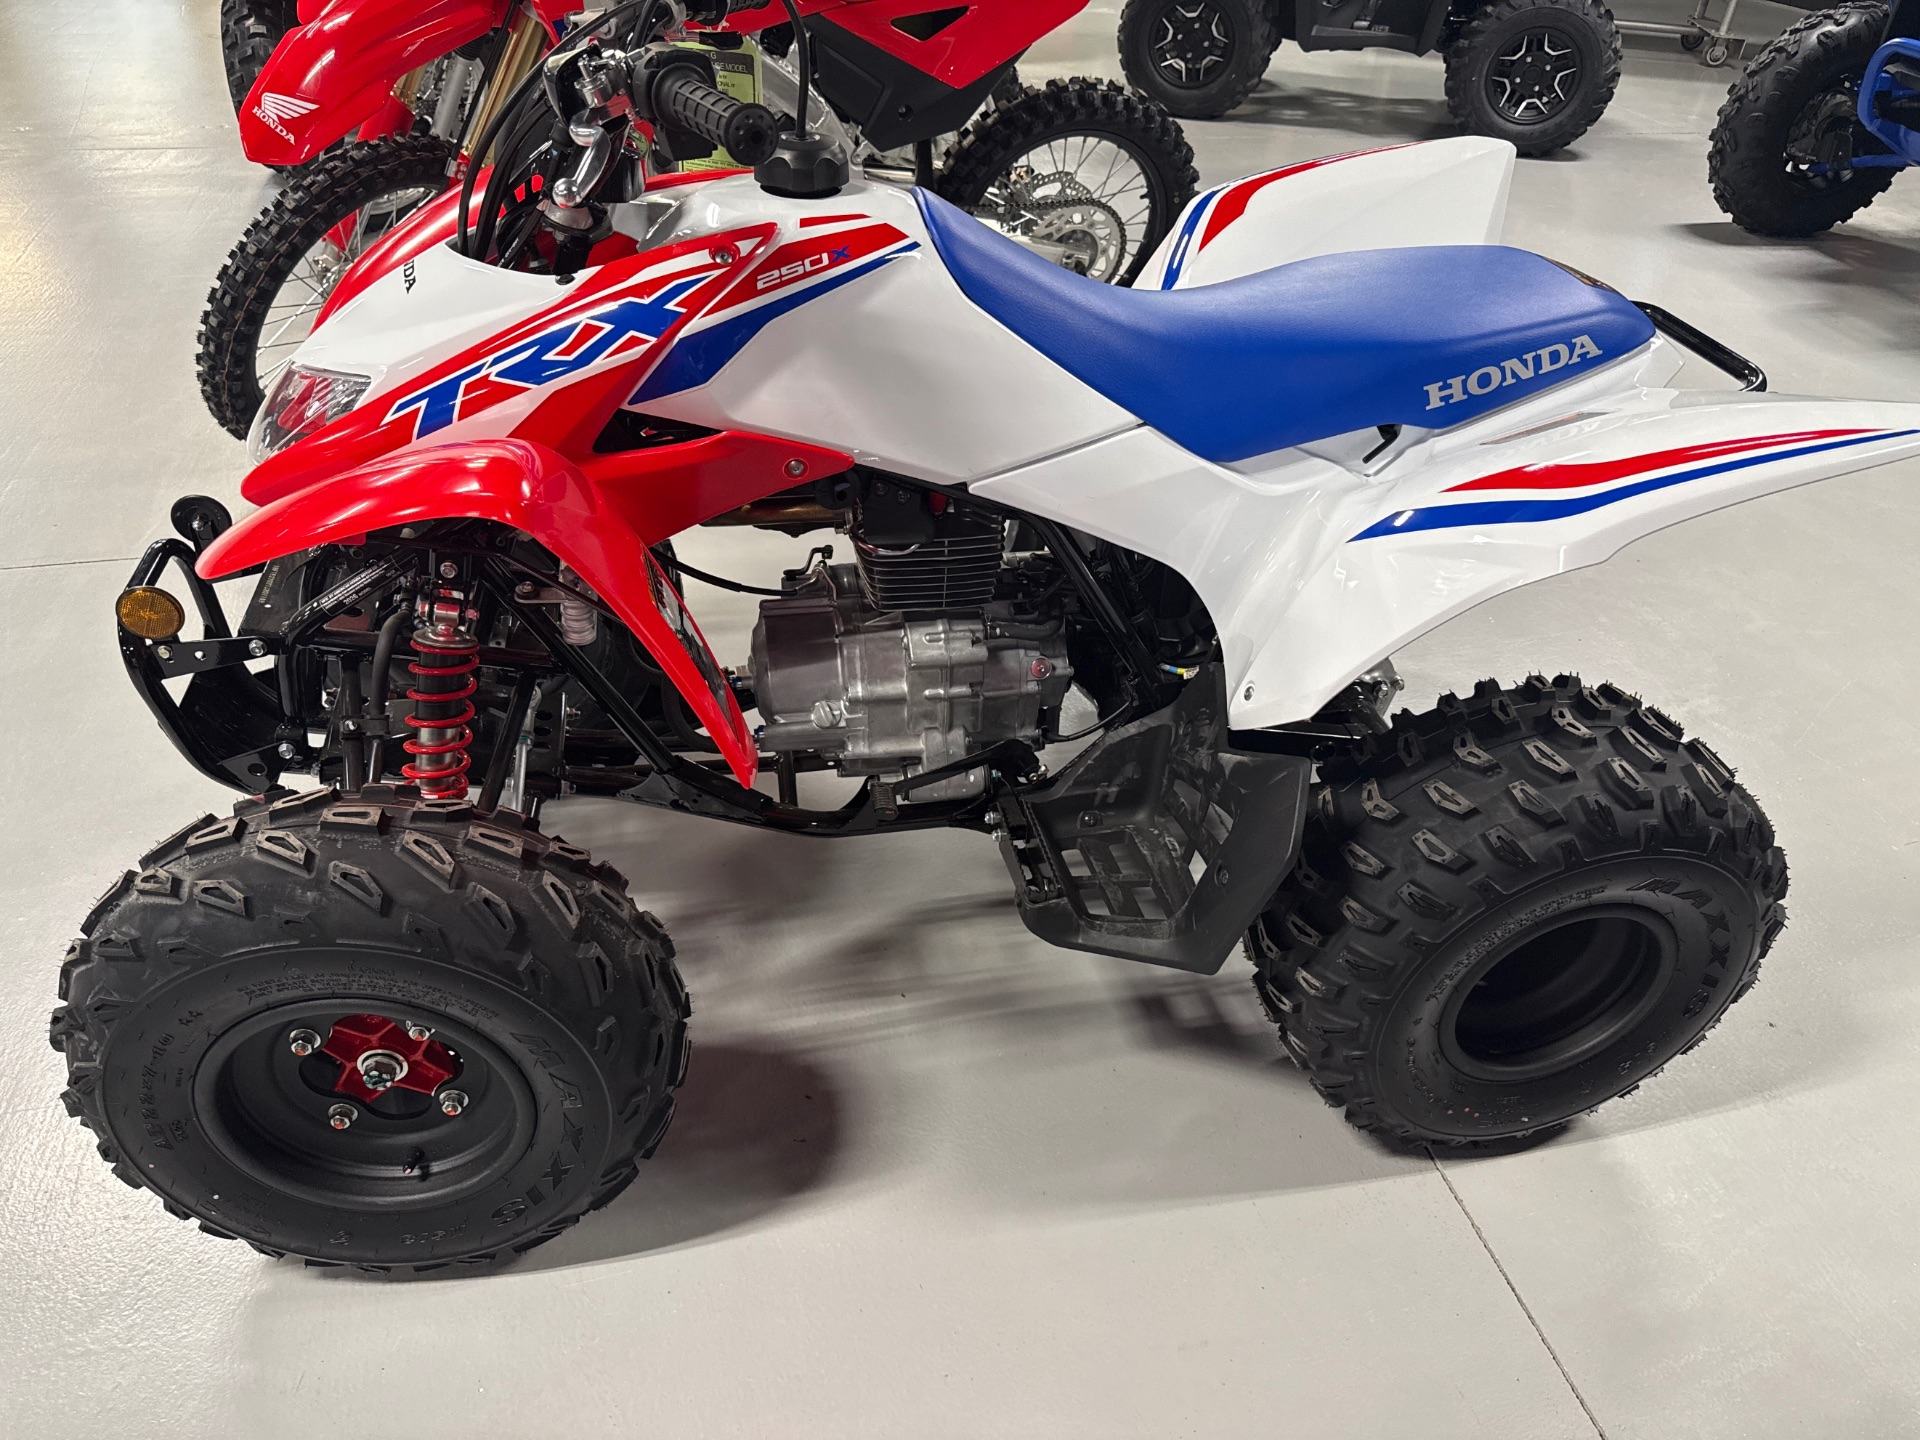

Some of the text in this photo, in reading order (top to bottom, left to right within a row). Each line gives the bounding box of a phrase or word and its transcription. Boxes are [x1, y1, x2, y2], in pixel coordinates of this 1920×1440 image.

[251, 105, 296, 146] HONDA
[756, 245, 852, 291] 250X
[384, 270, 722, 442] TRX
[1422, 334, 1603, 411] HONDA
[343, 593, 359, 605] 2026
[1626, 877, 1731, 1021] MAXXIS
[491, 1031, 586, 1227] MAXXIS
